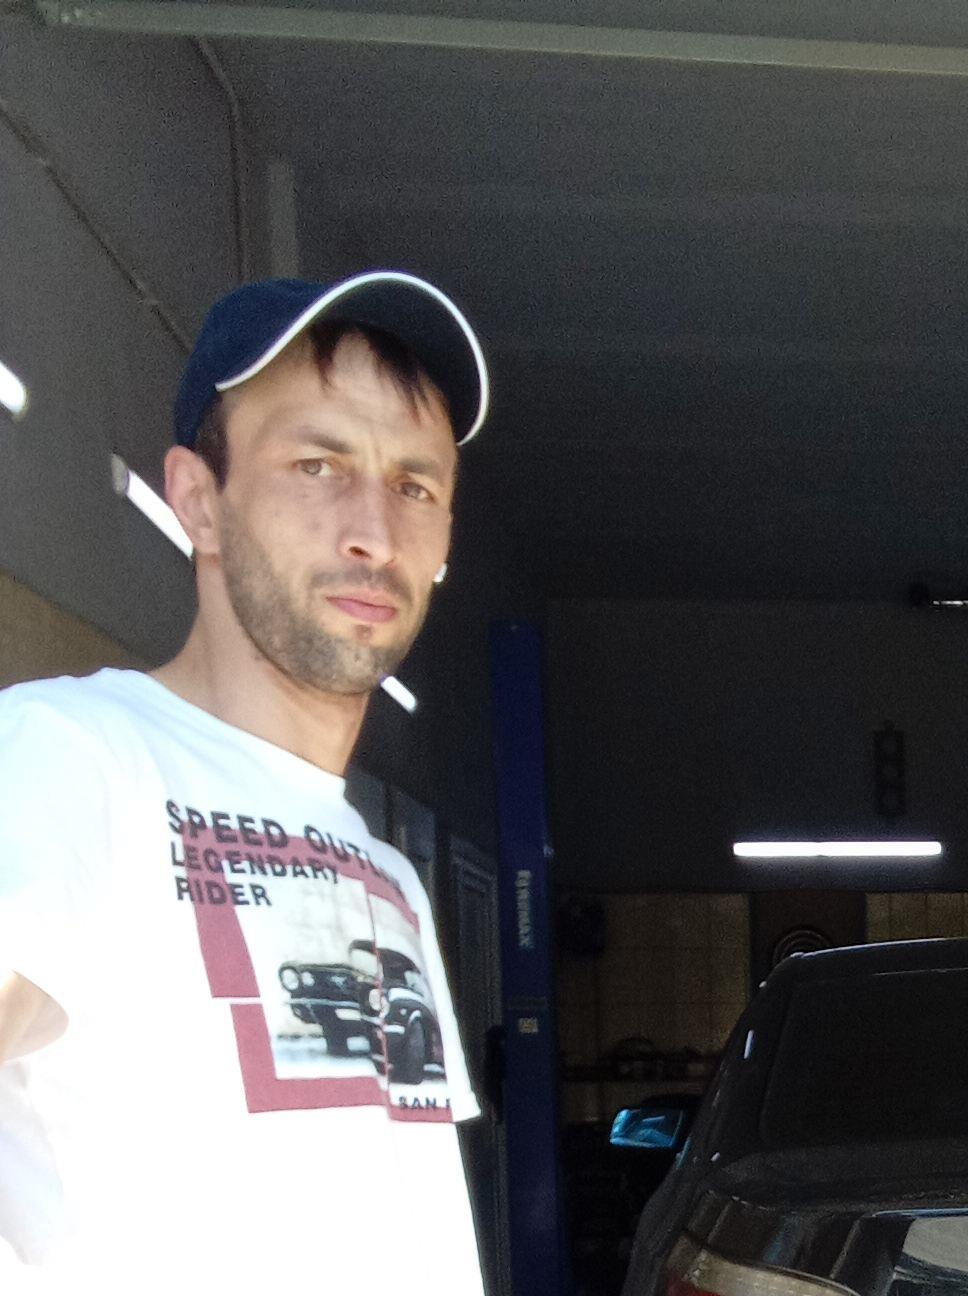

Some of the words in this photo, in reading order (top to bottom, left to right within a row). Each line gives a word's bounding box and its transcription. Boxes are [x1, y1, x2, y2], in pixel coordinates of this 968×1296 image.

[166, 799, 288, 848] SPEED
[171, 841, 340, 884] LEGENDARY
[175, 876, 273, 906] RIDER
[398, 1095, 437, 1111] SAN
